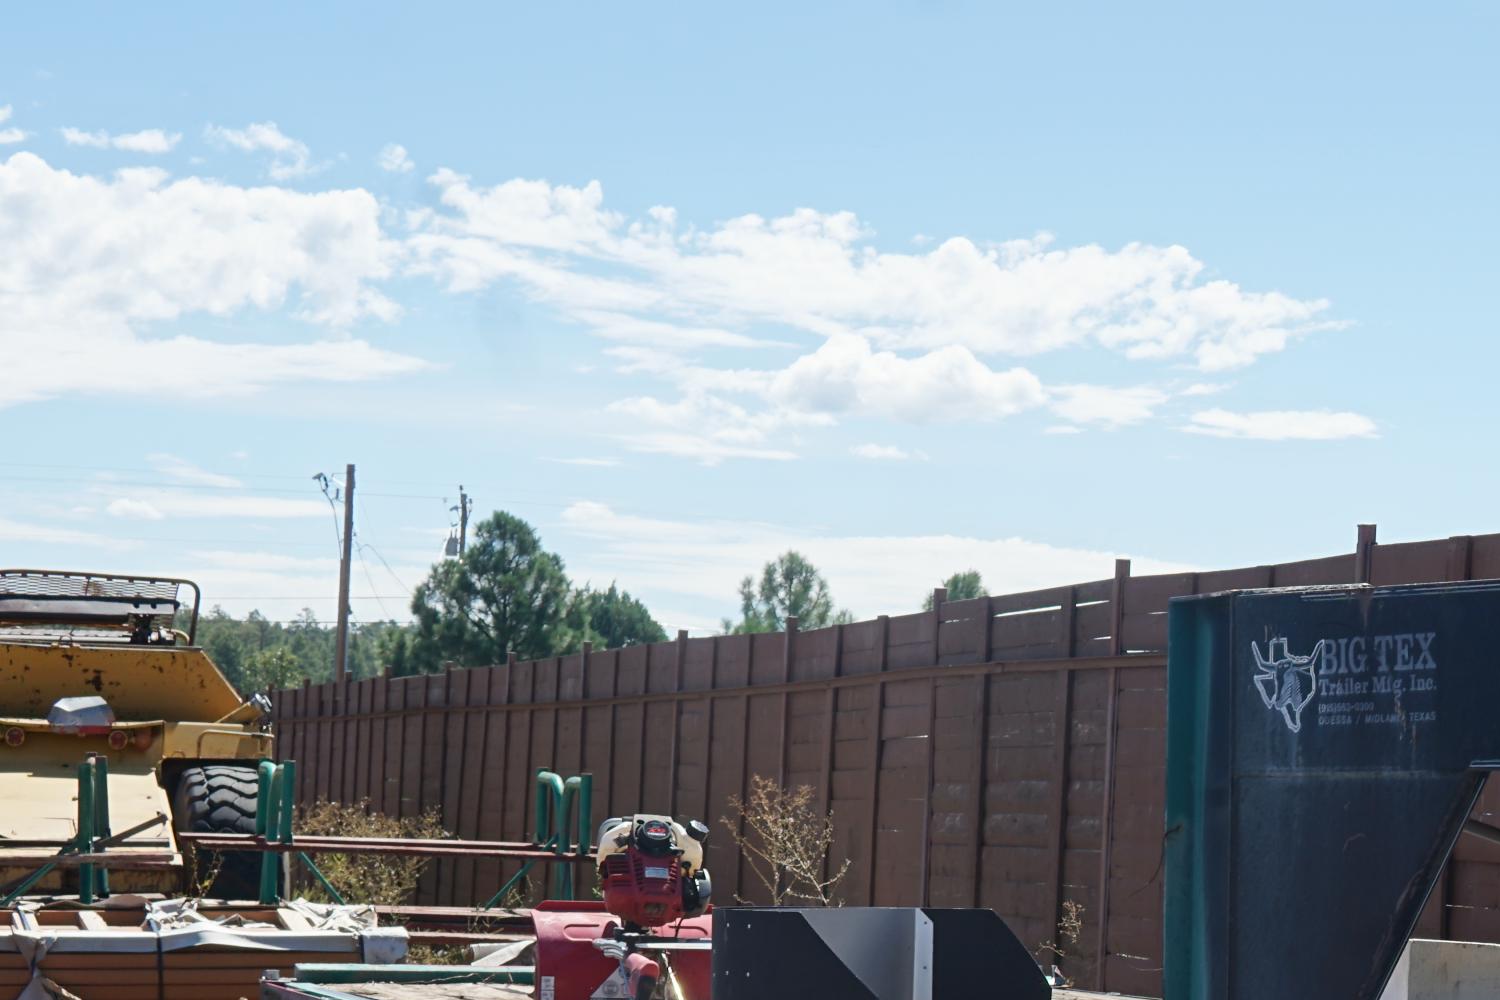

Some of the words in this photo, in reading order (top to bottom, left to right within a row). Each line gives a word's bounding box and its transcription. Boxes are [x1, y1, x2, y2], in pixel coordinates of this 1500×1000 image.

[1319, 637, 1367, 675] BIG
[1374, 633, 1437, 672] TEX
[1318, 677, 1369, 696] Trailer
[1372, 675, 1406, 698] Mfg.
[1409, 674, 1437, 692] Inc.
[1318, 714, 1352, 726] ODESSA
[1409, 711, 1437, 721] TEXAS
